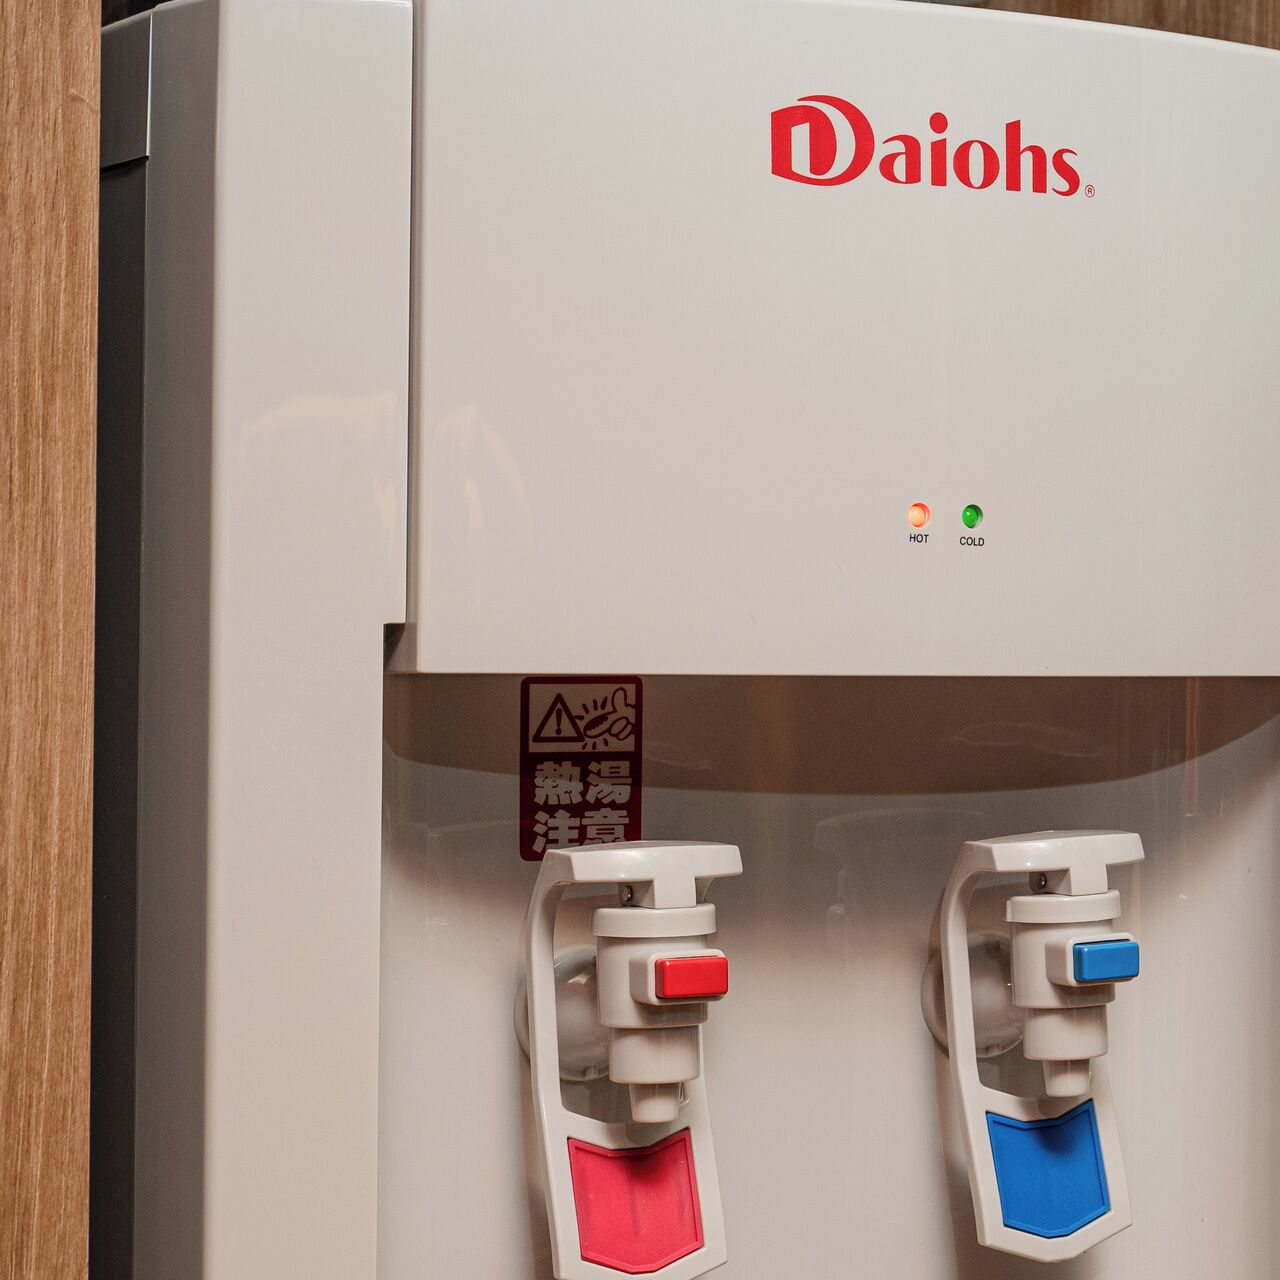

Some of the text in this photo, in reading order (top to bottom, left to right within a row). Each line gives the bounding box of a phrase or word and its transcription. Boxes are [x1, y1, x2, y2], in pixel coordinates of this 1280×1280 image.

[770, 94, 1081, 197] Daiohs
[909, 533, 930, 543] HOT
[960, 536, 985, 547] COLD
[533, 760, 633, 805] 熱湯
[532, 808, 630, 853] 注意
